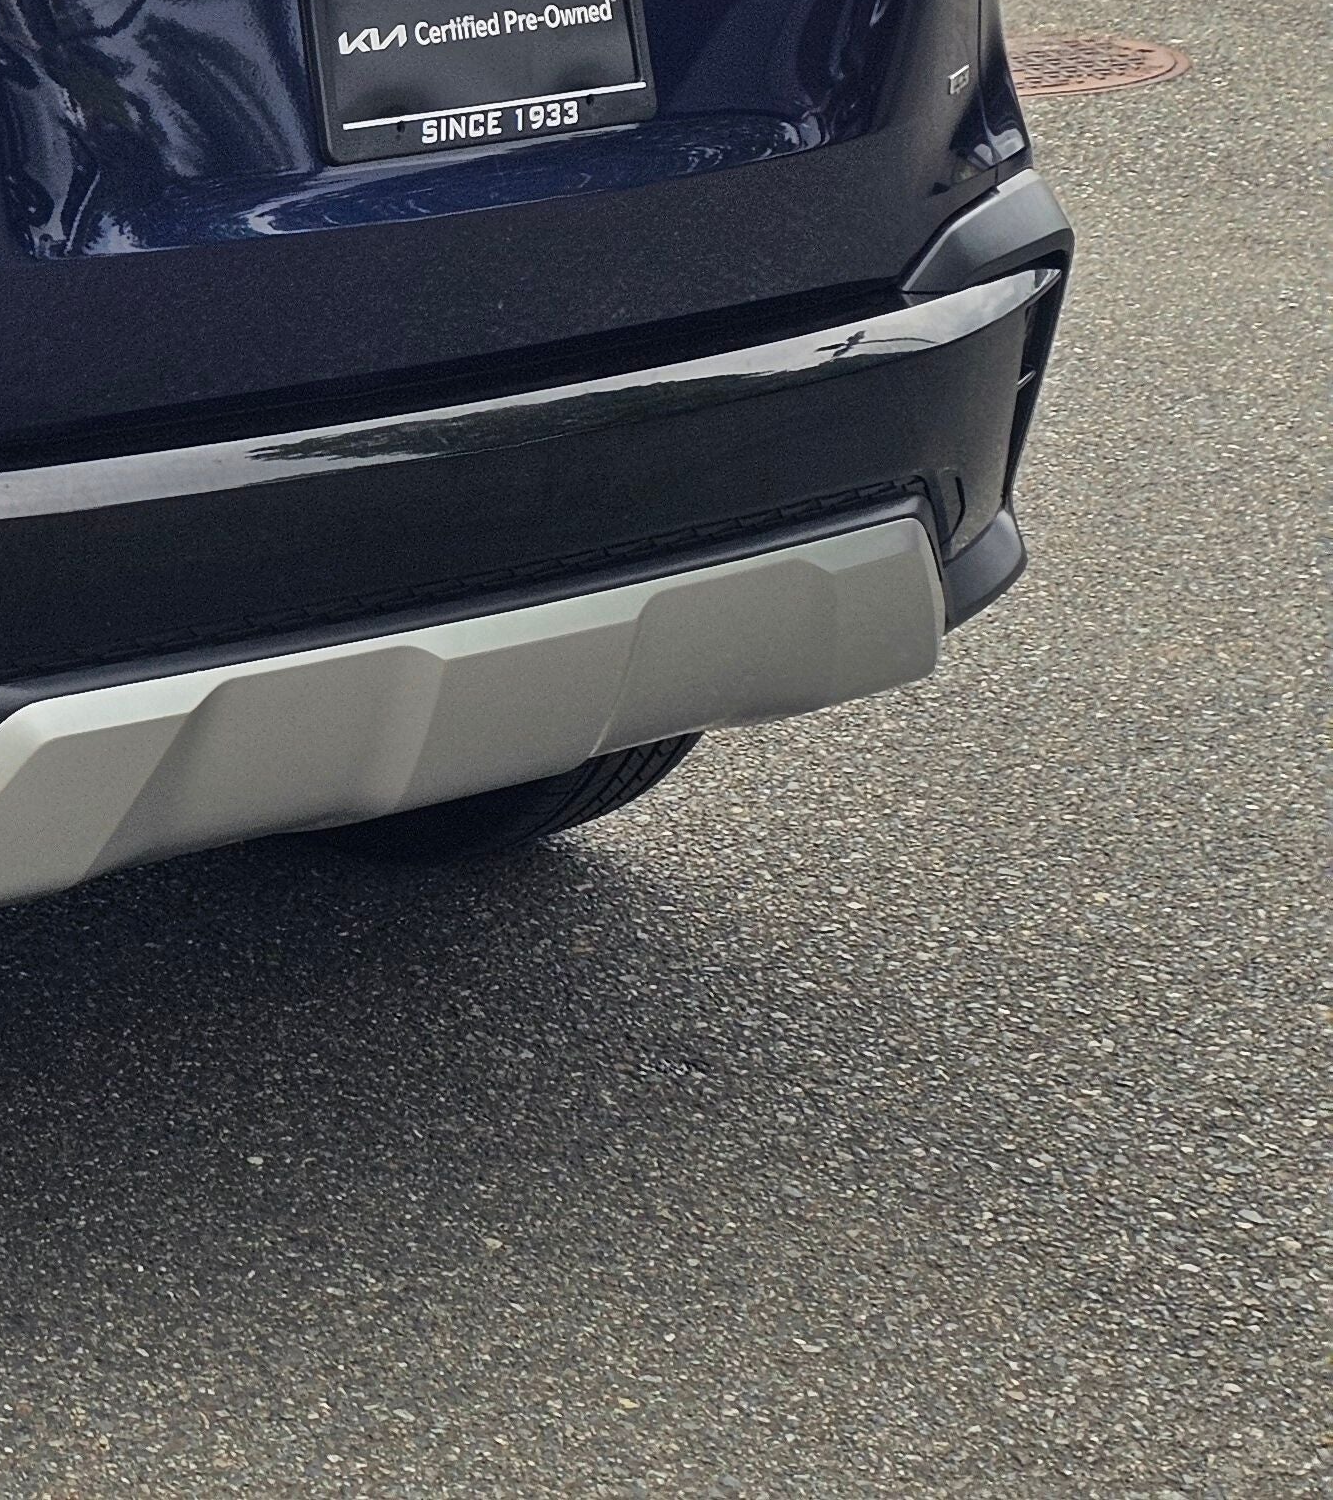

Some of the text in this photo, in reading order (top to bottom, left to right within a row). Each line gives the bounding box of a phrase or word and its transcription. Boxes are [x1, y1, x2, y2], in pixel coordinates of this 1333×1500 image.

[338, 24, 408, 55] KIA
[414, 11, 501, 46] Certified
[421, 100, 580, 144] SINCE 1933
